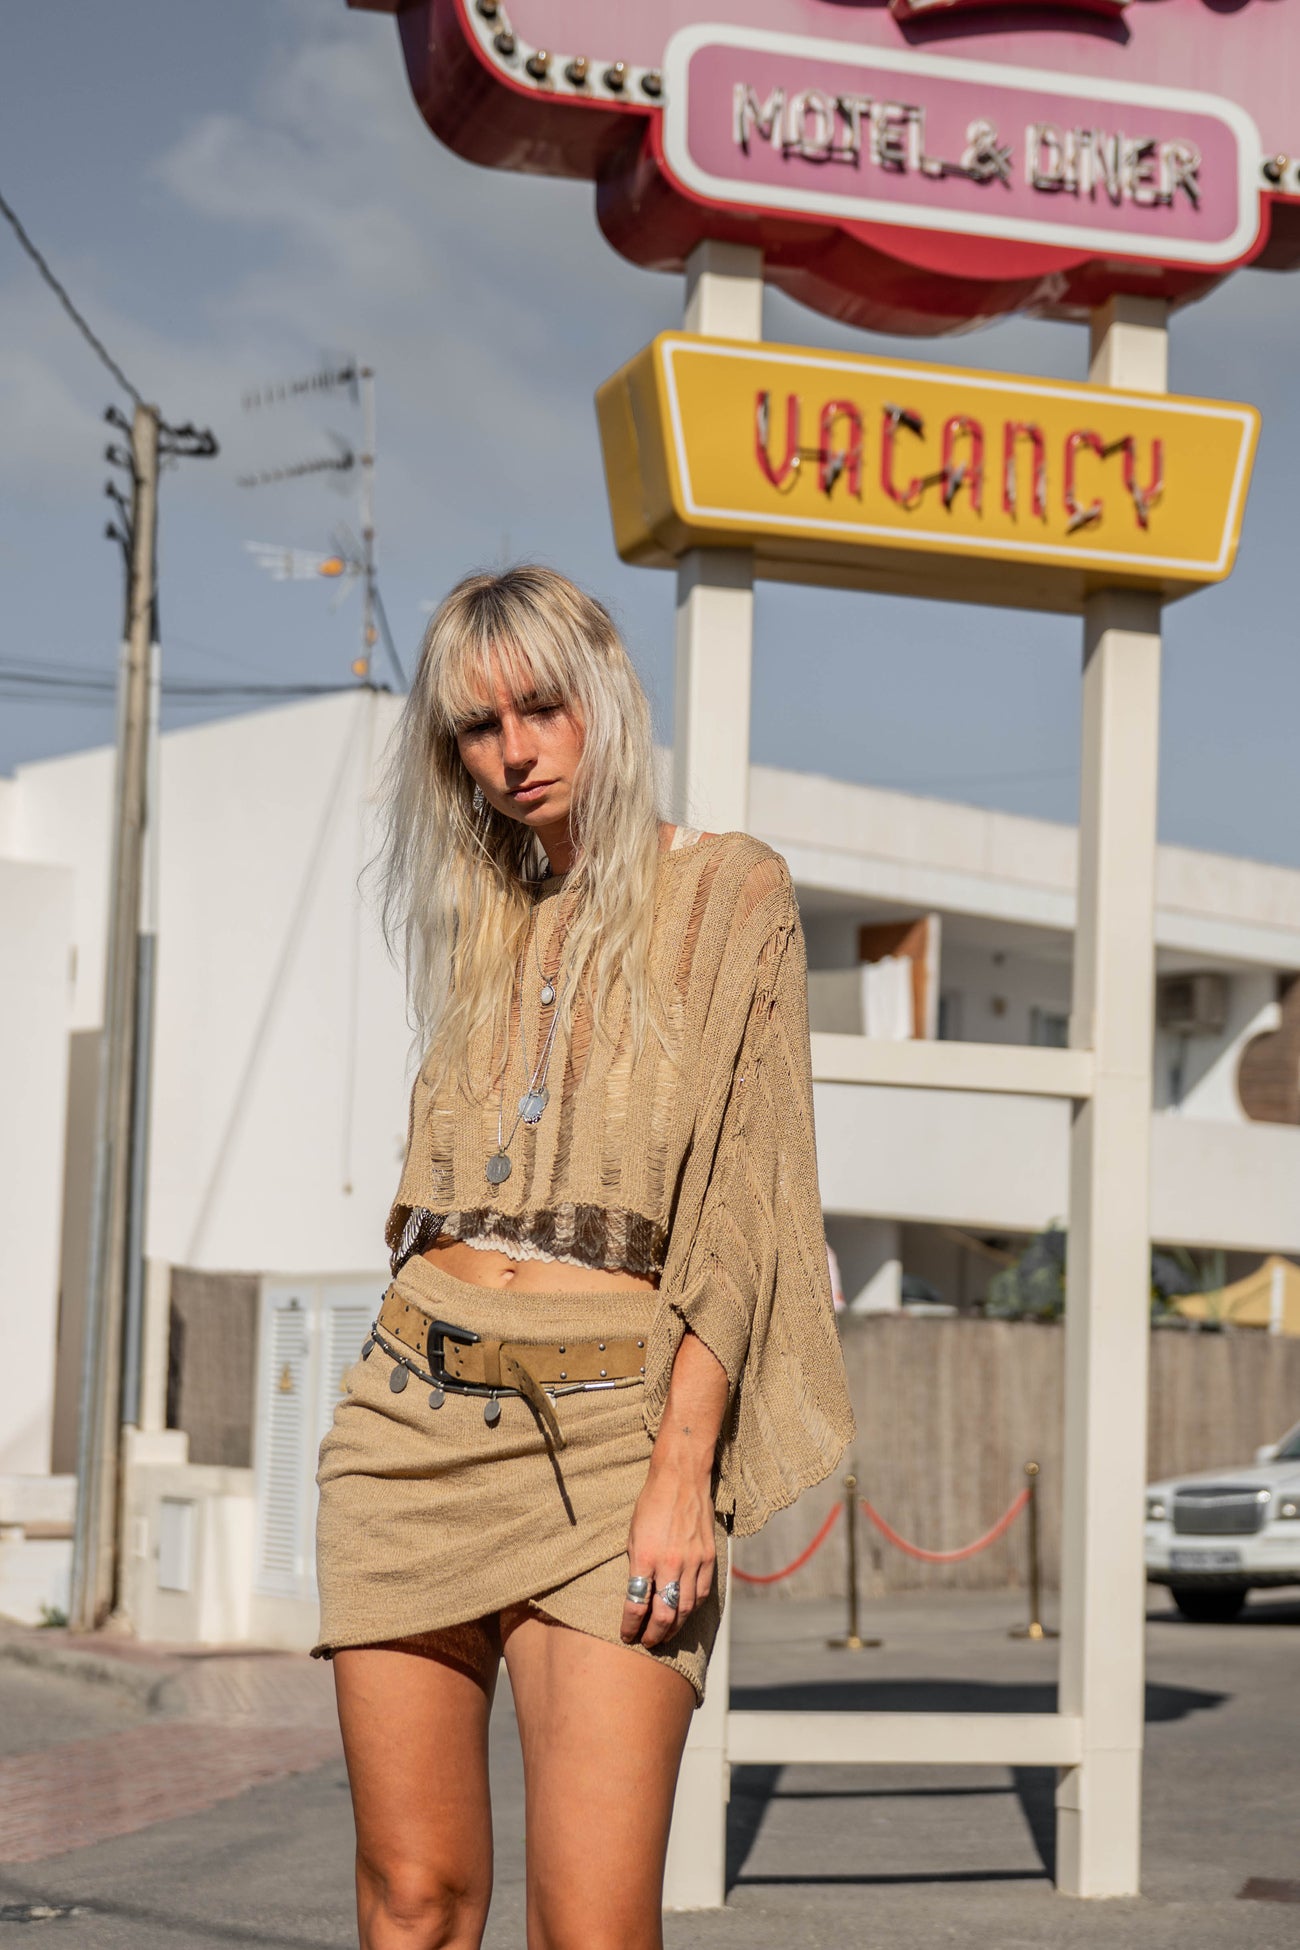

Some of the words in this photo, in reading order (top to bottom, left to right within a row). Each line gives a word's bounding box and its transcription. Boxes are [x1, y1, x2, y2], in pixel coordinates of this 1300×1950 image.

[732, 83, 943, 177] MOTEL
[962, 118, 1013, 184] &
[1025, 122, 1202, 209] DINER
[755, 389, 1163, 533] VACANCY
